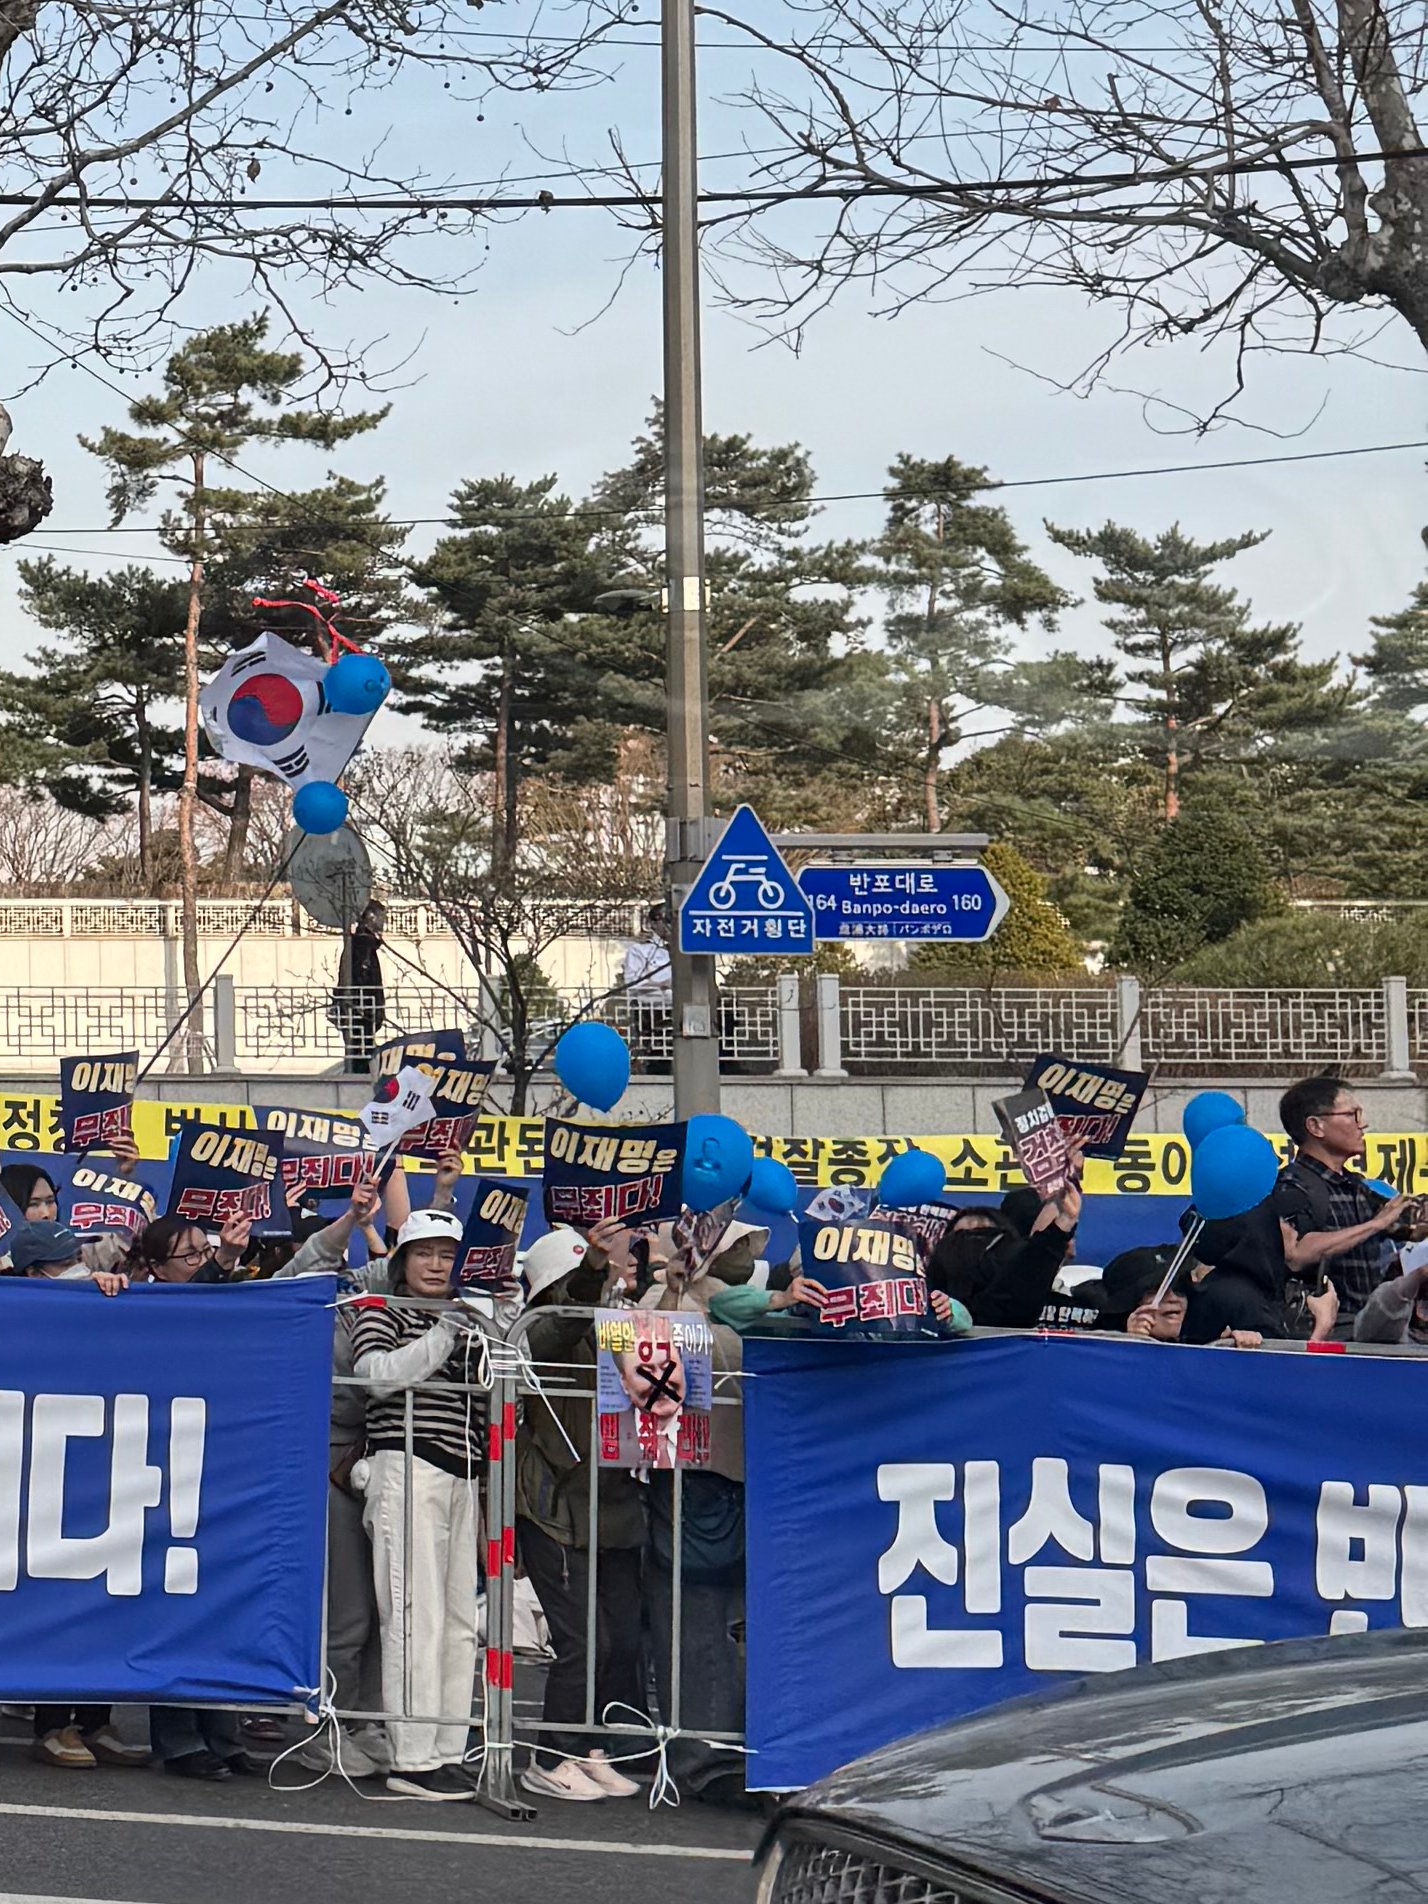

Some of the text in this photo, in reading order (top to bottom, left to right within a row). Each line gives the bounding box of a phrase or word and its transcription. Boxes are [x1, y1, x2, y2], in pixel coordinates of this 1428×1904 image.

[842, 900, 947, 917] Banpo-daero
[952, 894, 982, 911] 160
[849, 872, 939, 895] 반포대로
[692, 917, 807, 938] 자전거횡단
[191, 1131, 278, 1181] 이재명은
[550, 1127, 678, 1175] 이재명은
[550, 1173, 664, 1222] 무죄다!
[876, 1457, 1275, 1673] 진실은
